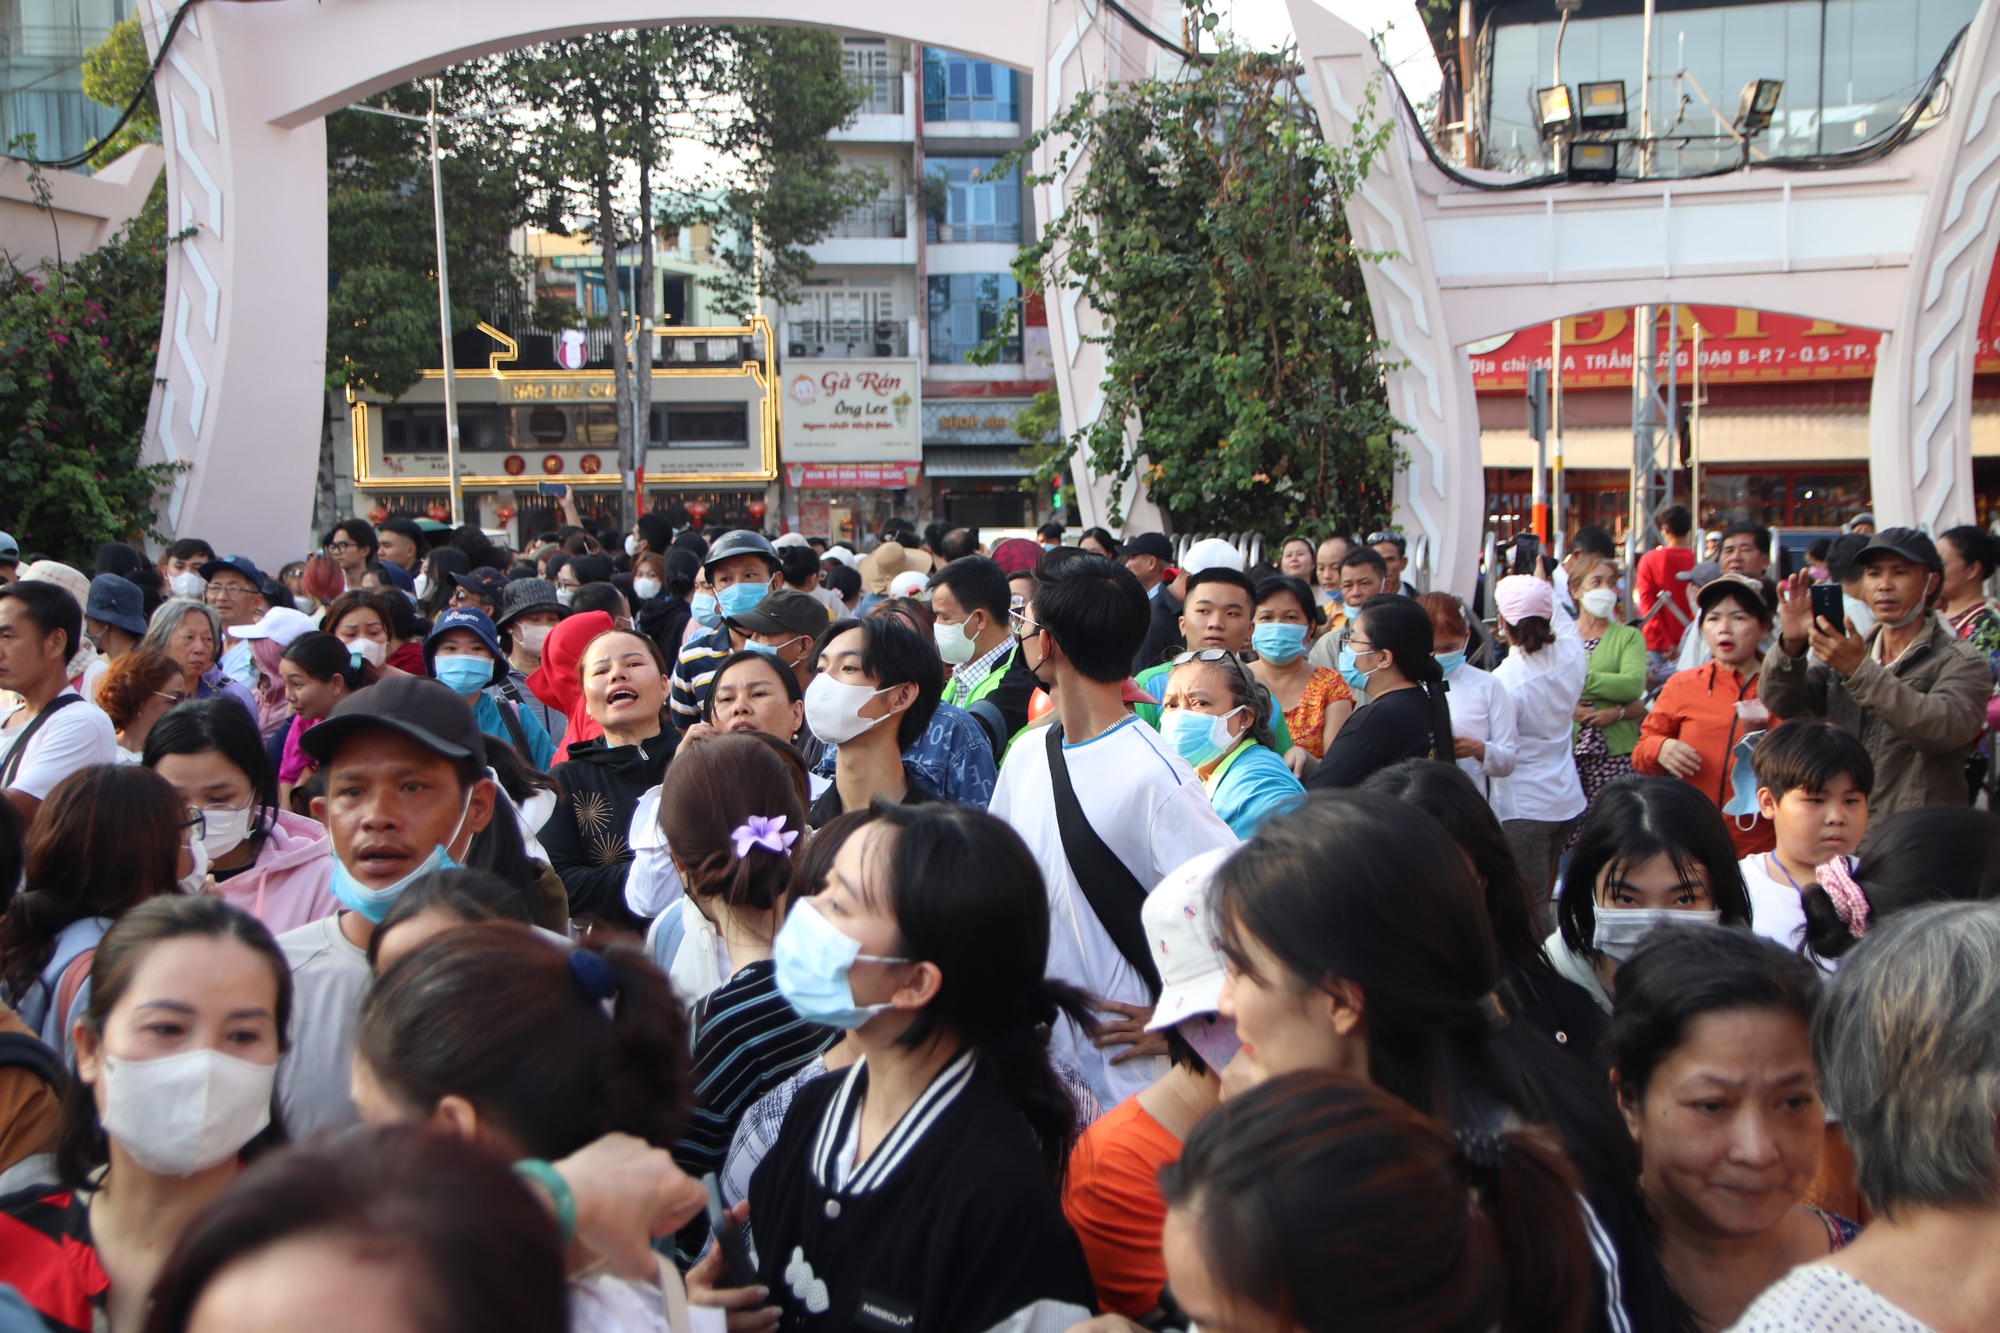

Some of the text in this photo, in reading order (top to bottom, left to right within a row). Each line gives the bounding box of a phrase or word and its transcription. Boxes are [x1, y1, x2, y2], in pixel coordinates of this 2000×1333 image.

[1470, 358, 1496, 376] Địa
[1584, 348, 1633, 370] TRẦN
[821, 371, 902, 398] Gà Rán
[835, 400, 888, 419] Ông Lee
[939, 416, 979, 429] SHOP
